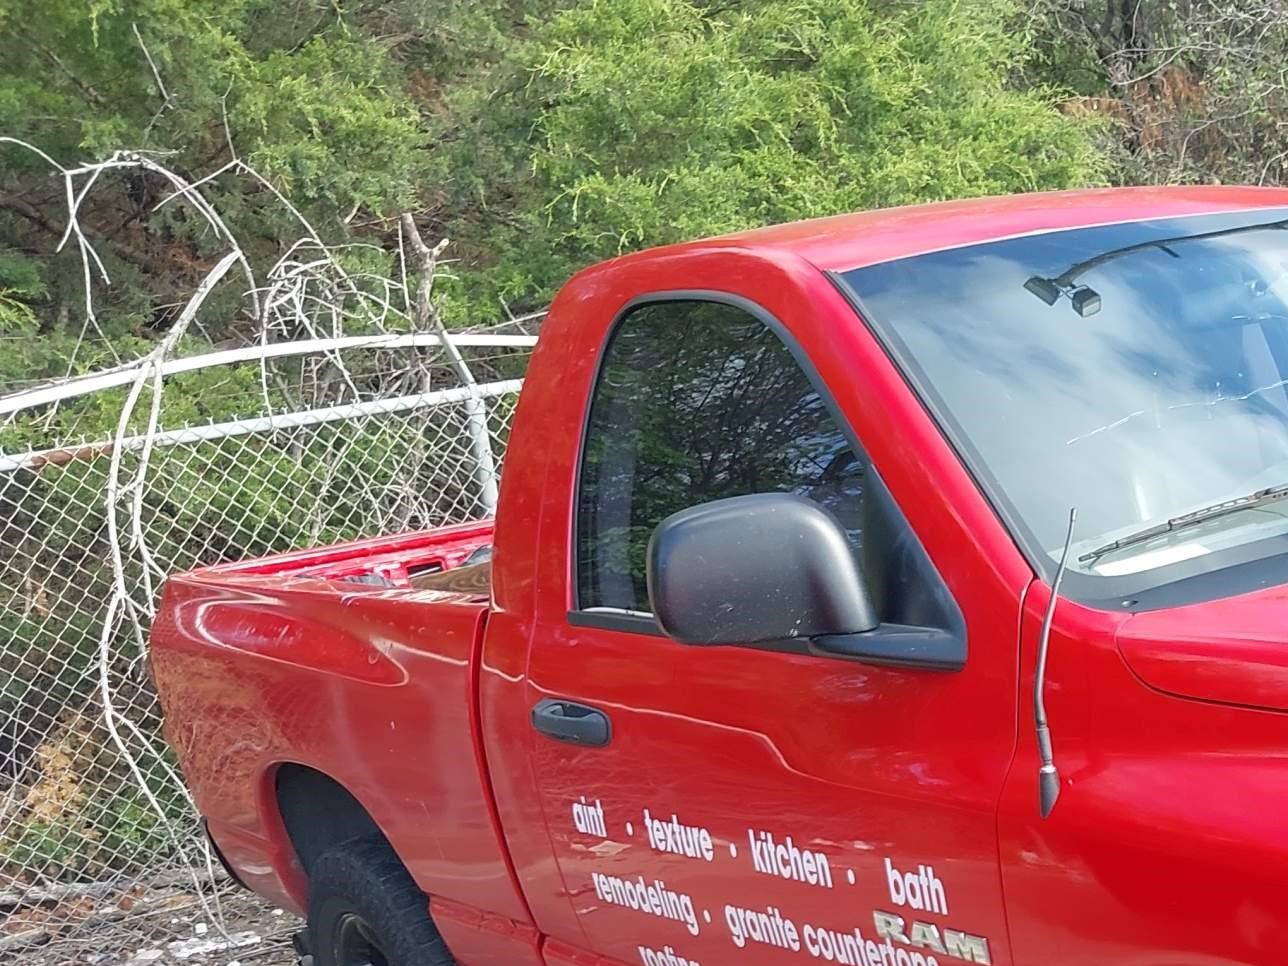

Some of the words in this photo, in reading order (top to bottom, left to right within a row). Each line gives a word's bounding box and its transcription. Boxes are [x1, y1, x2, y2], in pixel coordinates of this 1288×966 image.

[643, 808, 715, 862] texture
[748, 828, 833, 888] kitchen
[884, 857, 949, 915] bath
[591, 872, 699, 936] remodeling
[724, 904, 801, 952] granite
[872, 910, 992, 966] RAM
